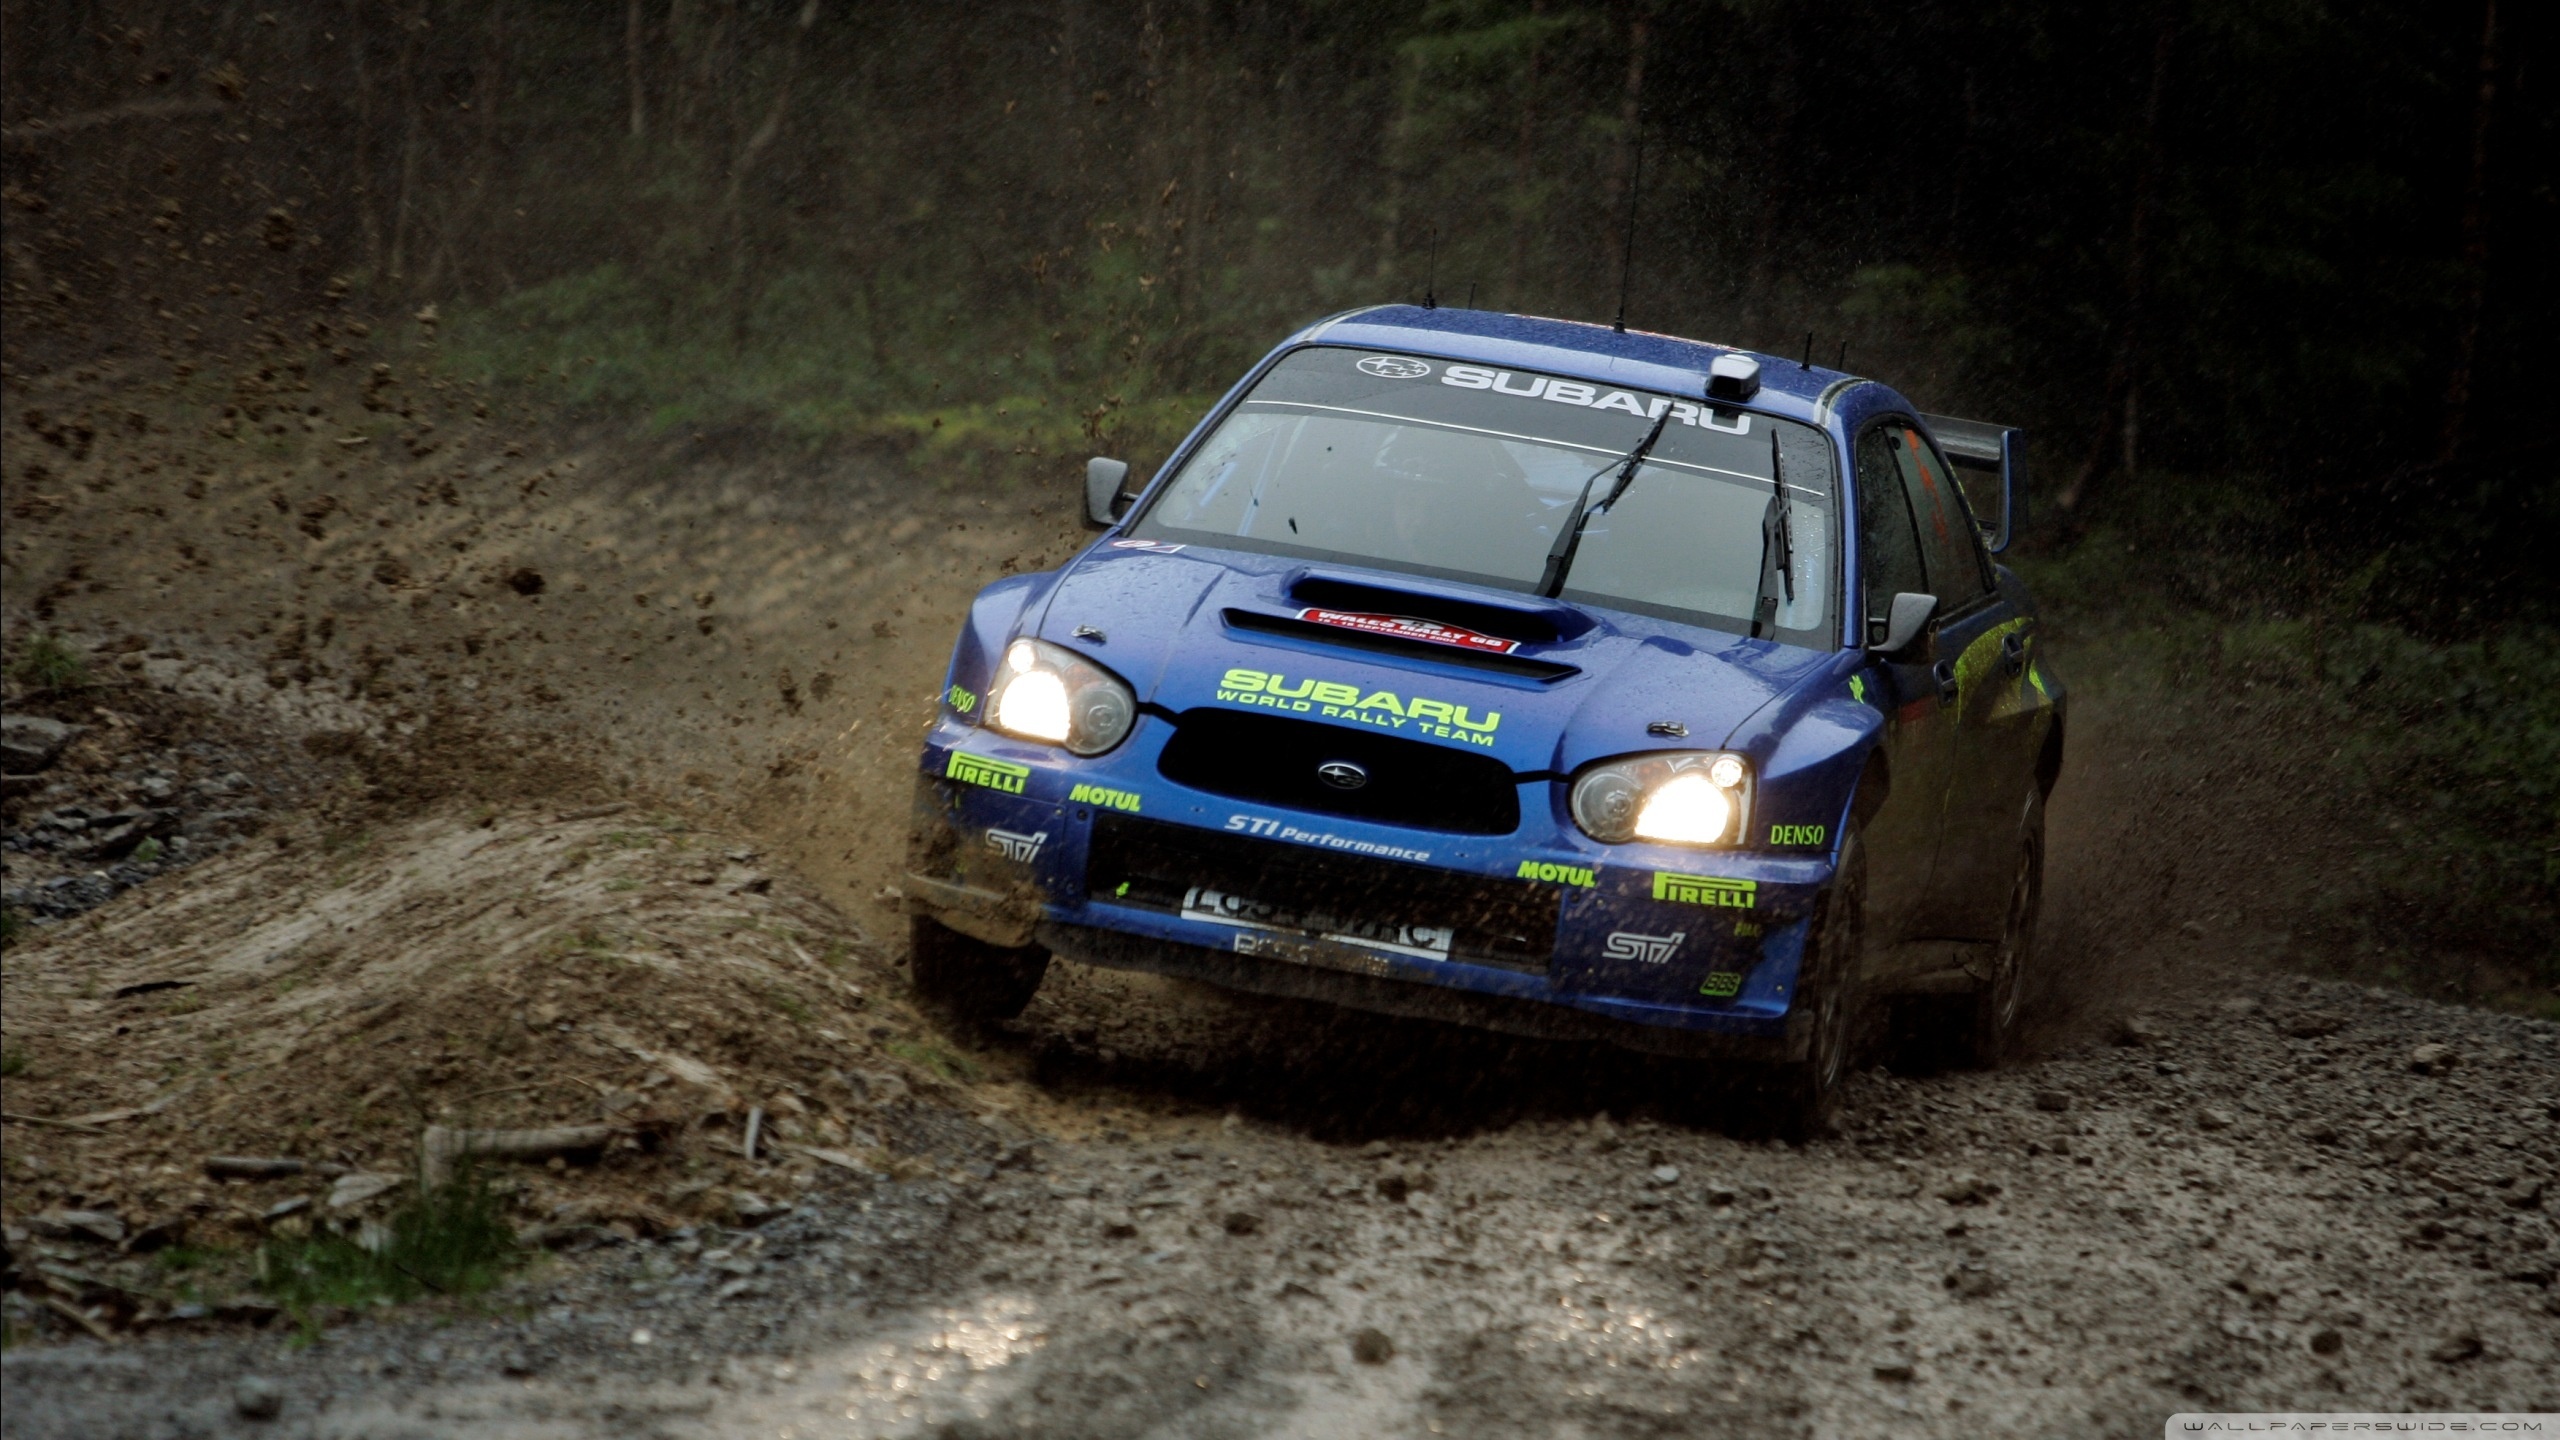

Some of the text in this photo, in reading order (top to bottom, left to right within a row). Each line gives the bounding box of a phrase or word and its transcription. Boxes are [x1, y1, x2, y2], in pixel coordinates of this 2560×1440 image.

[1441, 365, 1750, 436] SUBARU
[1318, 611, 1503, 647] WALES RALLY GB
[1357, 624, 1427, 639] SEPTEMBER
[948, 684, 977, 713] DENSO
[1220, 669, 1500, 732] SUBARU
[1216, 690, 1494, 746] WORLD RALLY TEAM
[946, 750, 1031, 794] PIRELLI
[1069, 783, 1141, 812] MOTUL
[1224, 815, 1430, 862] STI Performance
[1770, 825, 1825, 845] DENSO
[1516, 860, 1596, 888] MOTUL
[1652, 871, 1757, 909] PIRELLI
[1702, 973, 1740, 993] BBS
